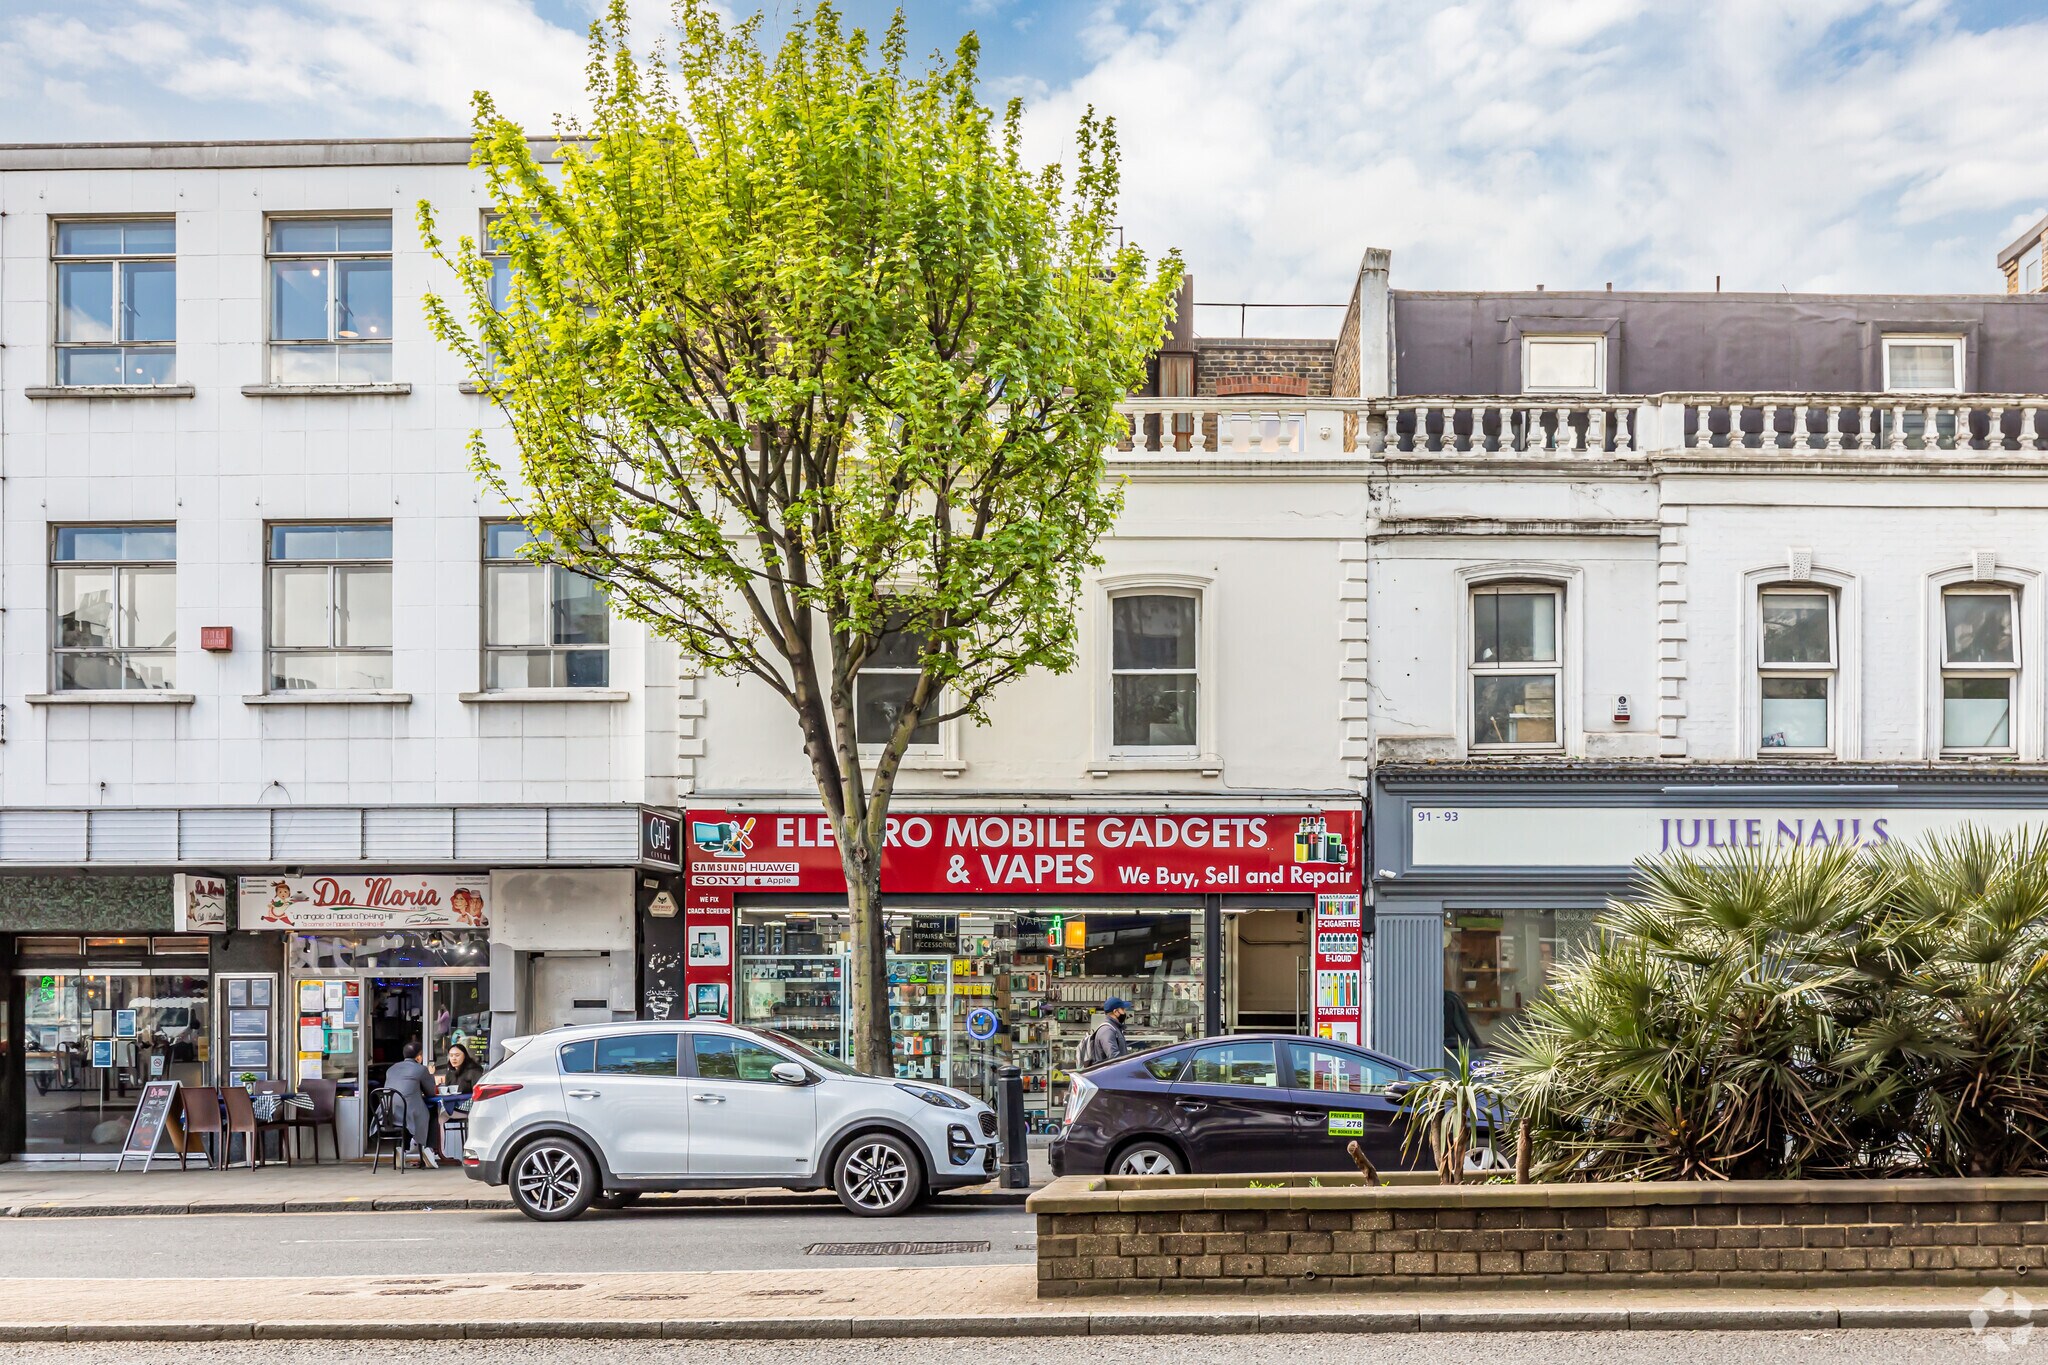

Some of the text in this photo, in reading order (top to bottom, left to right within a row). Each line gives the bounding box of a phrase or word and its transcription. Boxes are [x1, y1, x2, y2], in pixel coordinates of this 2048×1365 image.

[1418, 812, 1433, 822] 91
[1444, 812, 1459, 822] 93
[776, 817, 1268, 849] ELERO MOBILE GADGETS
[1660, 818, 1889, 854] JULIE NAILS
[650, 850, 670, 860] CINEMA
[693, 863, 796, 872] SAMSUNG HUAWEI
[946, 854, 1094, 884] & VAPES
[695, 876, 791, 885] SONY Apple
[1118, 866, 1353, 888] We Buy, Sell and Repair
[312, 877, 441, 906] Da Maria
[1318, 919, 1361, 928] E-CIGARETTES
[1325, 954, 1352, 962] E-LIQUID
[1318, 1007, 1359, 1015] STARTER KITS
[1346, 1120, 1362, 1128] 278
